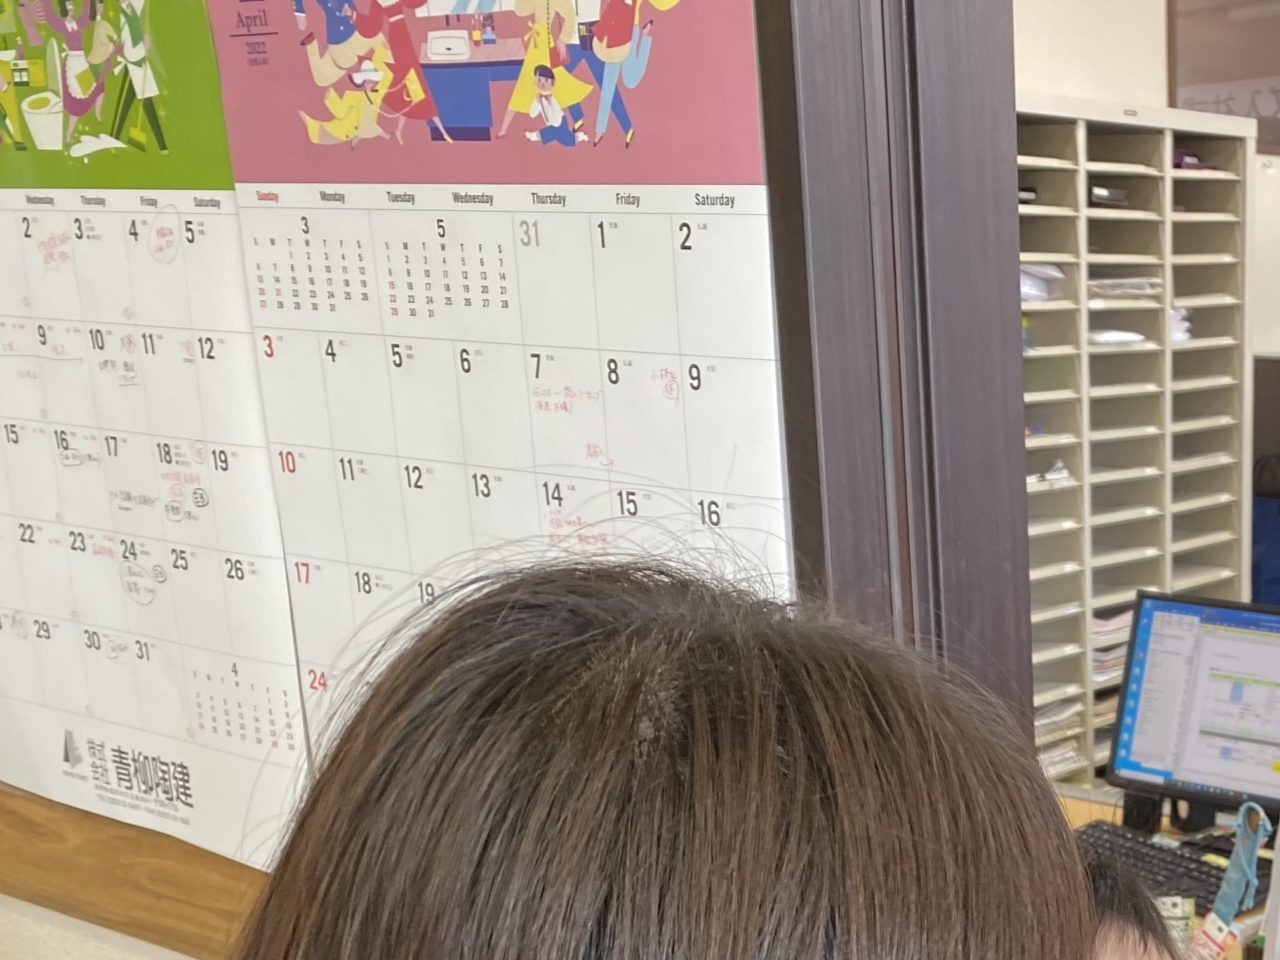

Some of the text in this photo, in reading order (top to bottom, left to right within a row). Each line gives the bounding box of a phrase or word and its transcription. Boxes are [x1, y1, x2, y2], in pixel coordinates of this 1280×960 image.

[237, 10, 268, 32] April
[256, 191, 735, 208] Sunday Monday Tuesday Wednesday Thursday Friday Saturday
[22, 217, 31, 238] 2
[74, 218, 83, 239] 3
[129, 220, 138, 241] 4
[185, 221, 194, 243] 5
[301, 217, 309, 234] 3
[437, 219, 445, 237] 5
[520, 220, 692, 250] 31 1 2
[38, 325, 46, 345] 9
[89, 329, 104, 350] 10
[142, 333, 155, 354] 11
[198, 337, 215, 359] 12
[263, 335, 274, 357] 3
[326, 340, 336, 362] 4
[391, 344, 402, 367] 5
[460, 349, 471, 373] 6
[531, 354, 540, 378] 7
[608, 359, 619, 384] 8
[689, 364, 701, 390] 9
[4, 424, 228, 471] 15 16 17 18 19
[279, 451, 720, 526] 10 11 12 13 14 15 16
[19, 523, 35, 543] 22
[69, 531, 86, 552] 23
[120, 540, 137, 561] 24
[171, 549, 188, 570] 25
[225, 558, 244, 580] 26
[295, 562, 435, 603] 17 18 19
[34, 620, 149, 661] 29 30 31
[232, 663, 238, 677] 4
[308, 669, 327, 691] 24
